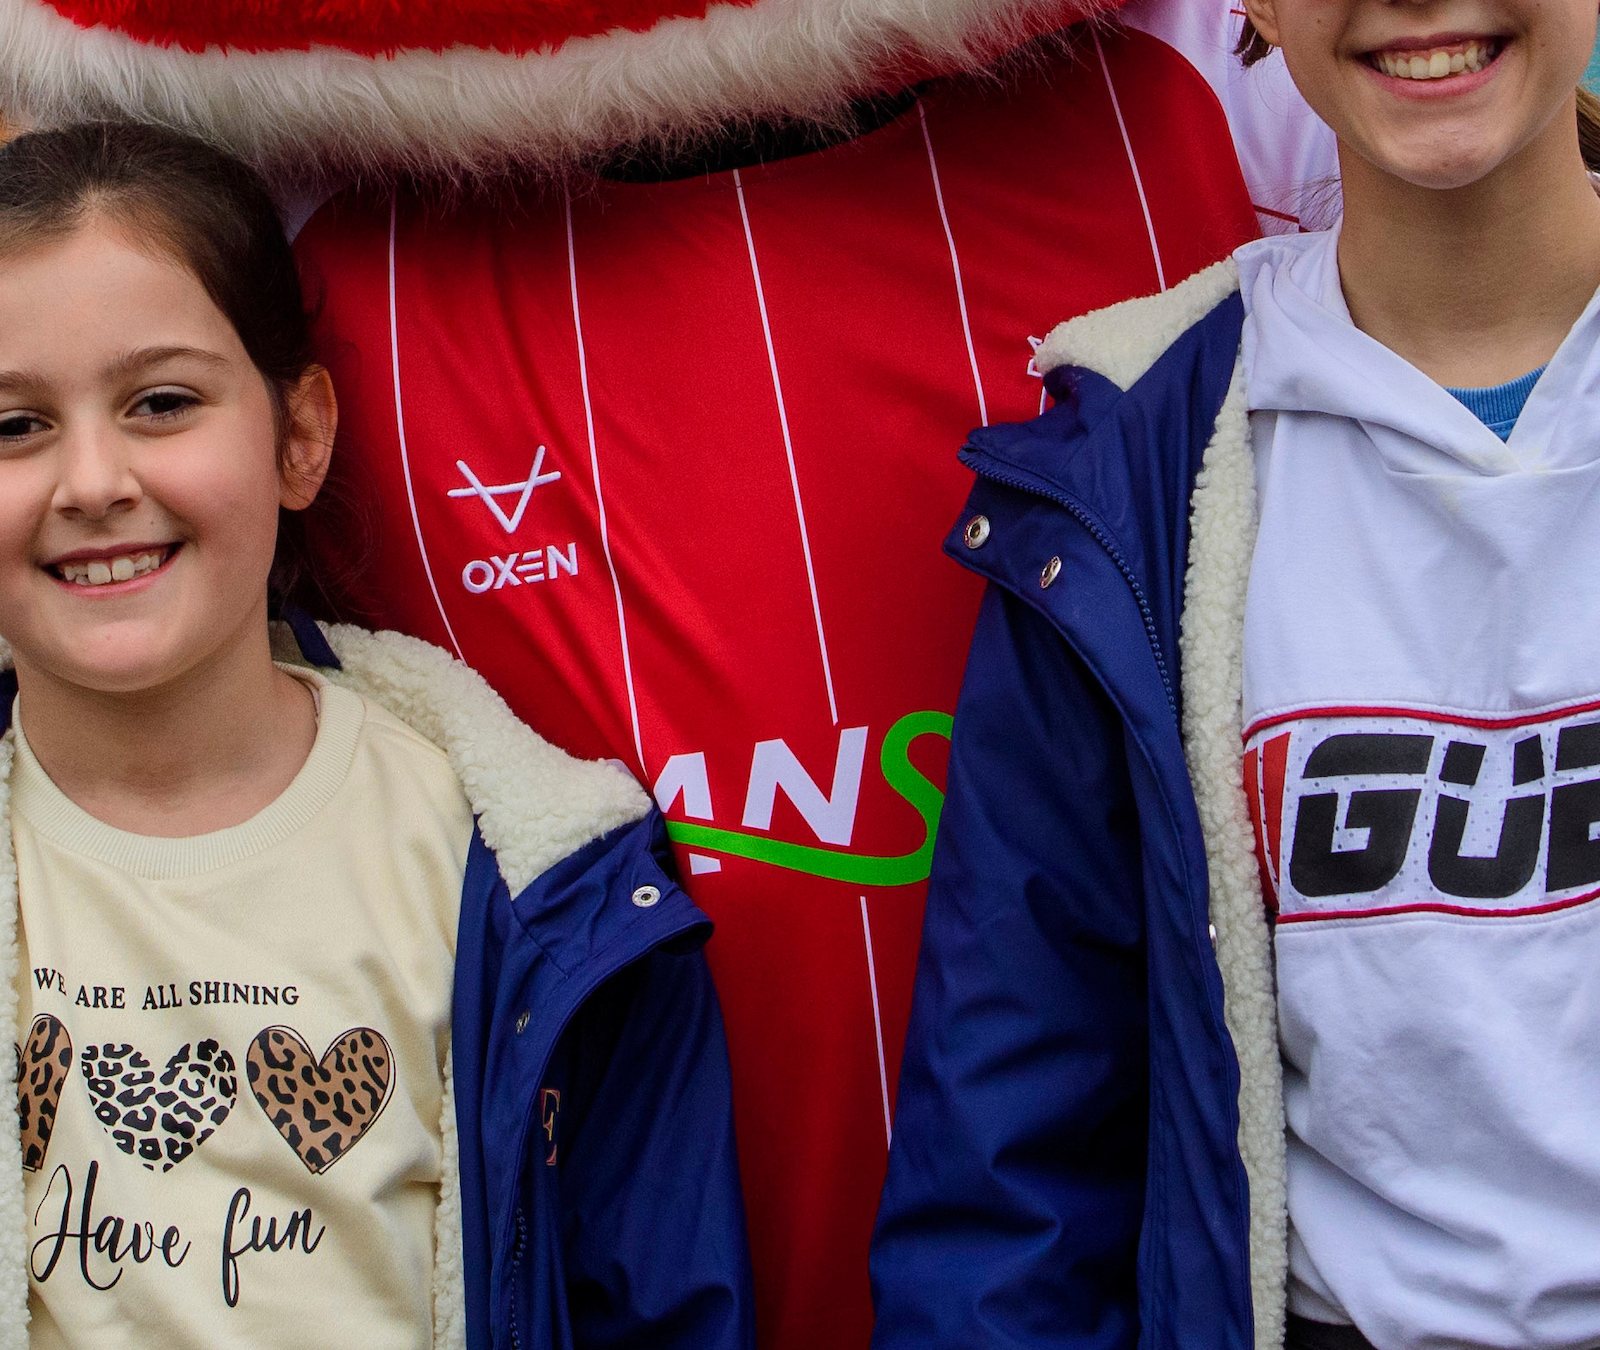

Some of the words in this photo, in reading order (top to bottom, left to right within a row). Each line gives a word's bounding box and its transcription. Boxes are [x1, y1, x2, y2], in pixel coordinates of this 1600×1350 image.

[462, 542, 578, 594] OXEN
[33, 967, 67, 996] WE
[75, 985, 125, 1009] ARE
[142, 983, 182, 1010] ALL
[189, 981, 299, 1005] SHINING
[31, 1160, 191, 1290] Have
[222, 1187, 326, 1308] fun
